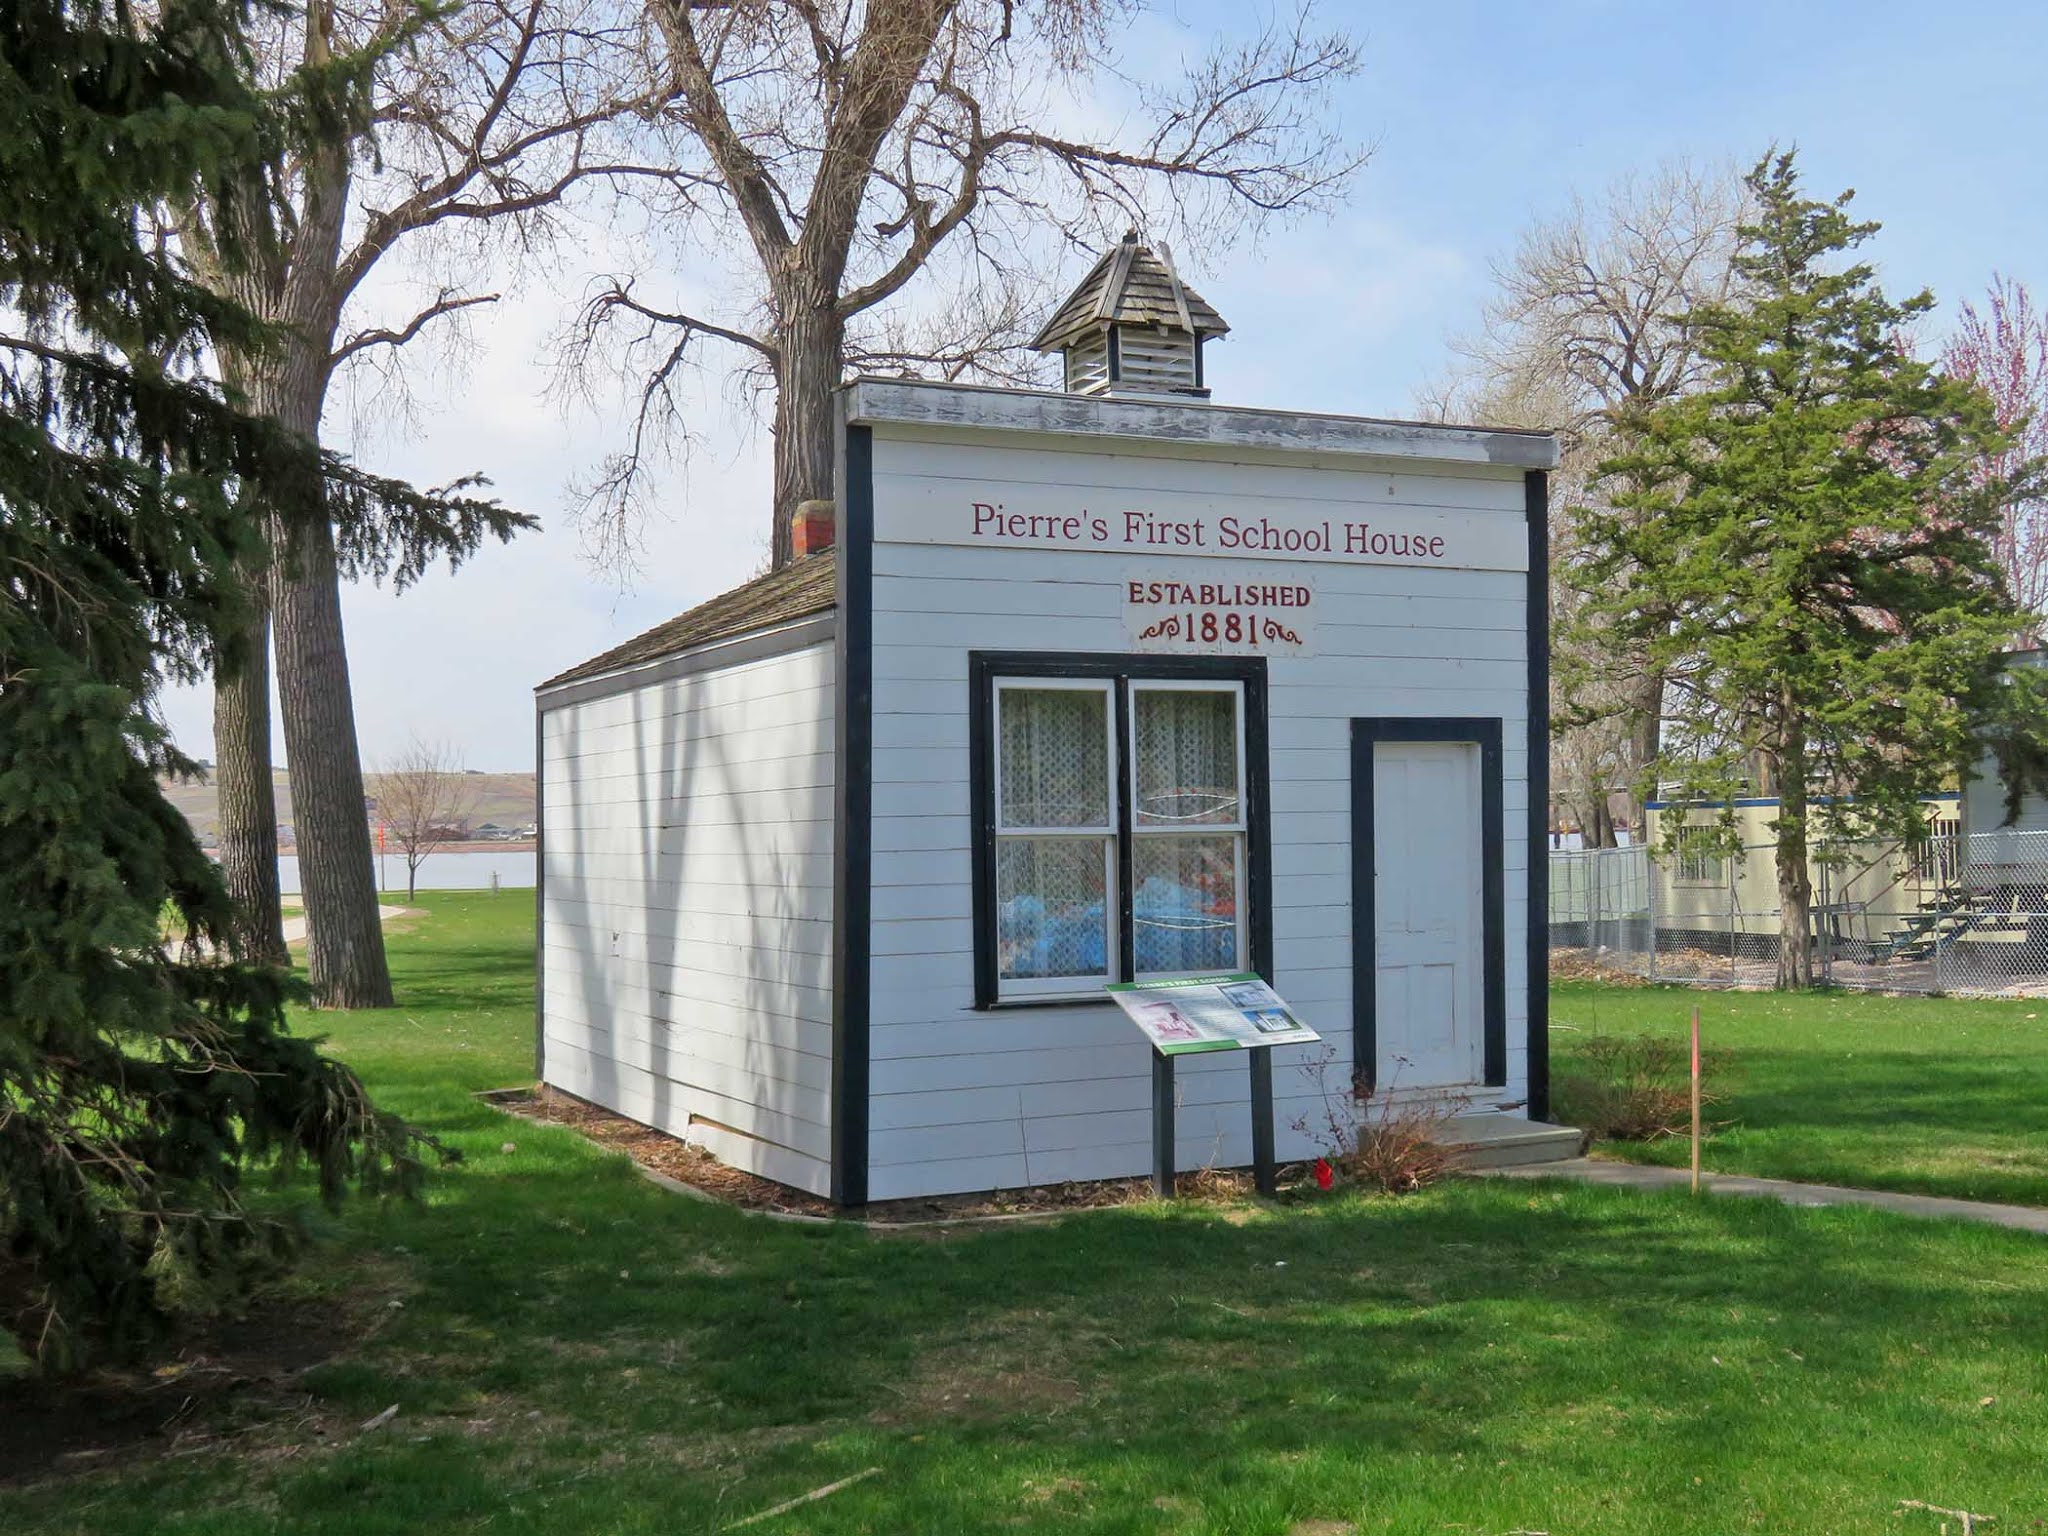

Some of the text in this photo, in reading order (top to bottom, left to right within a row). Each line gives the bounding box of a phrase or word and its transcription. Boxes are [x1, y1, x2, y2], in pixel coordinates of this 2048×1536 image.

[971, 503, 1445, 557] Pierre's First School House
[1129, 581, 1311, 607] ESTABLISHED
[1186, 612, 1258, 644] 1881
